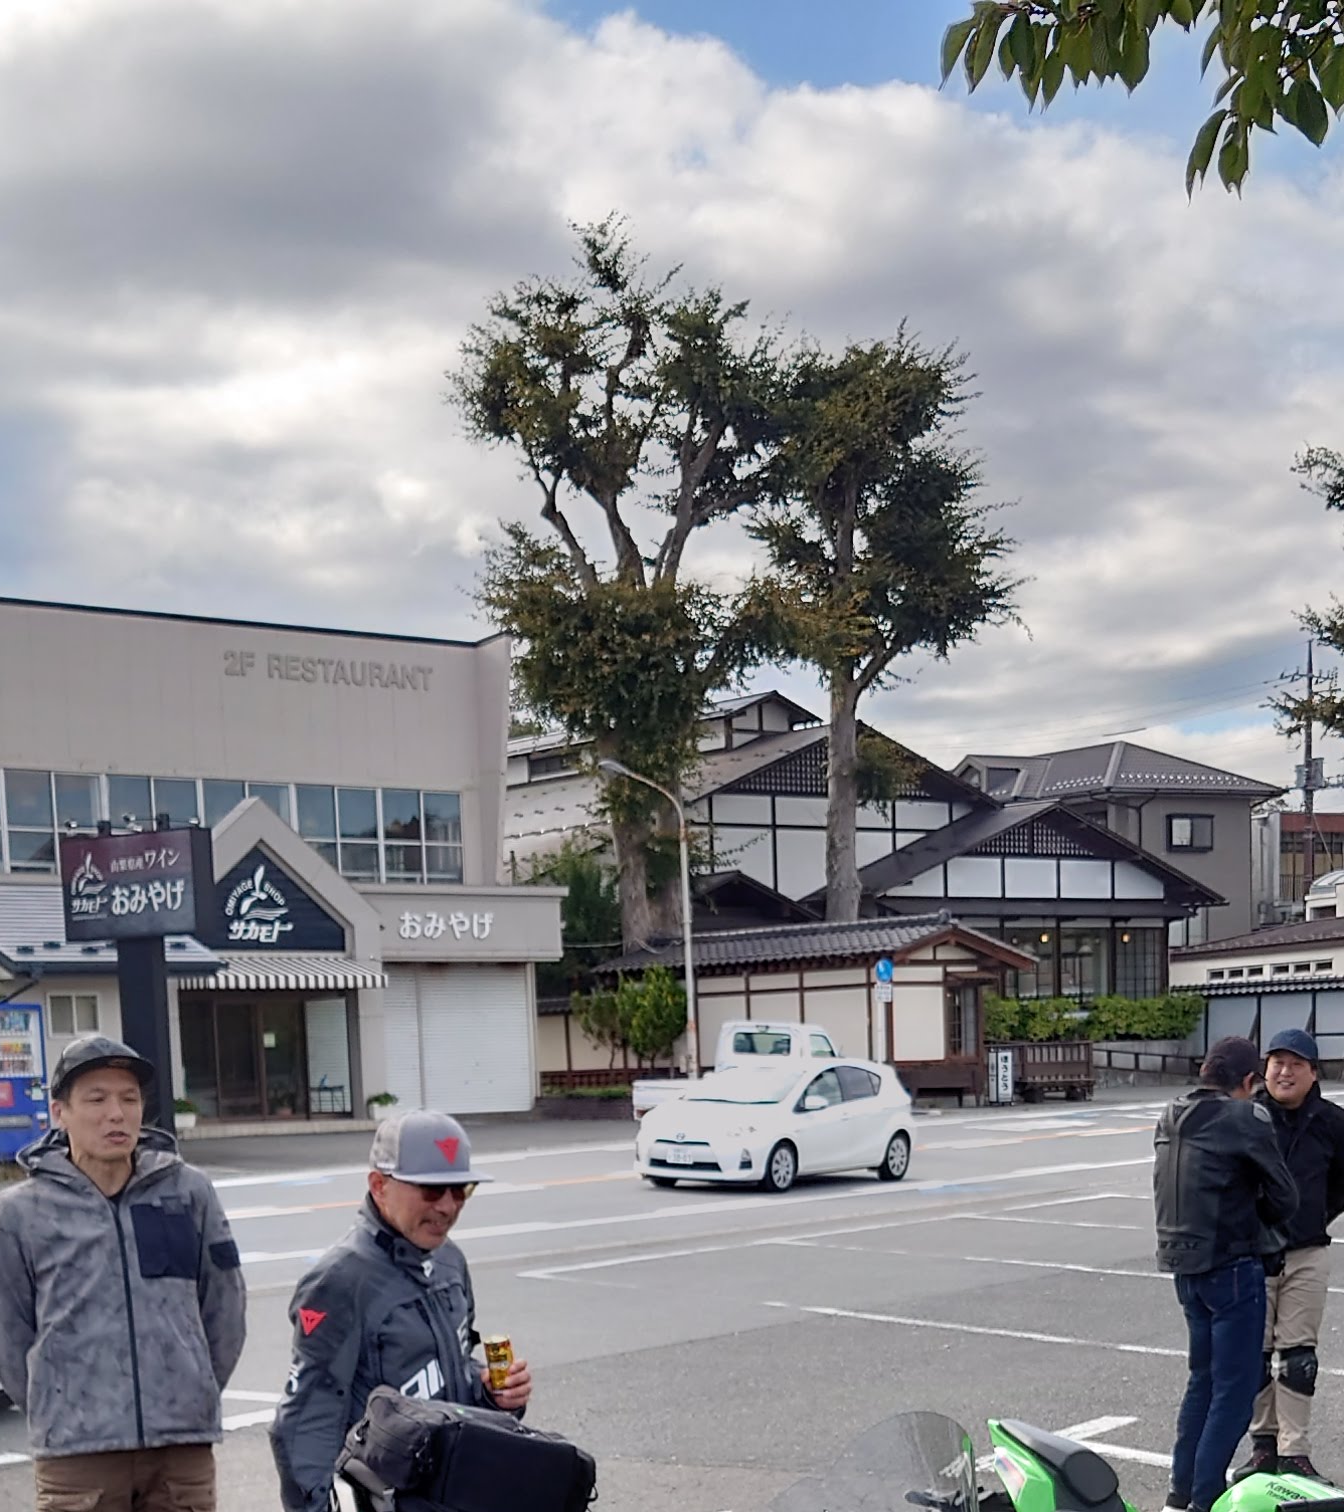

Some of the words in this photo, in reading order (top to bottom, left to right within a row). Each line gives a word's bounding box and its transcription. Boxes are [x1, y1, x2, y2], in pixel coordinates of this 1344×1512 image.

[223, 651, 255, 677] 2F
[267, 654, 433, 691] RESTAURANT
[111, 878, 185, 916] おみやげ
[224, 879, 254, 916] OMIYAGE
[263, 883, 286, 907] SHOP
[228, 920, 294, 943] サカモト
[399, 911, 494, 940] おみやげ
[1000, 1055, 1009, 1091] ほうとう
